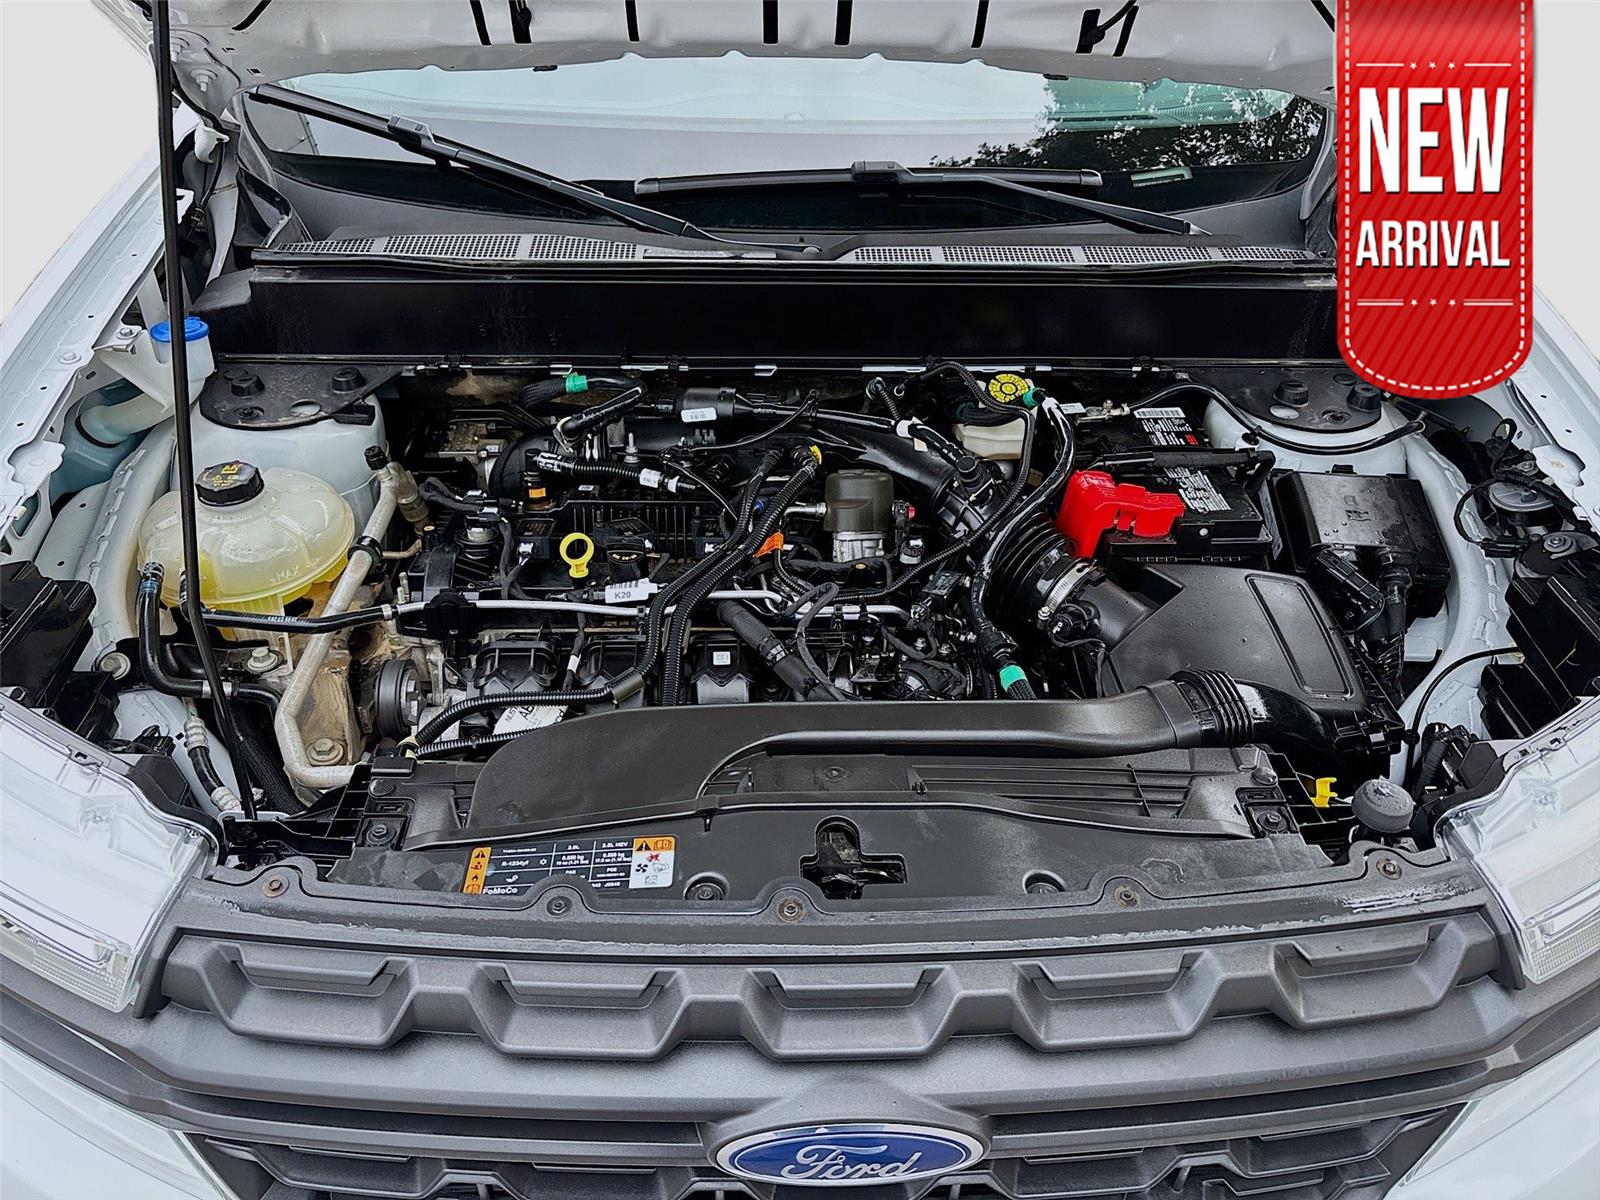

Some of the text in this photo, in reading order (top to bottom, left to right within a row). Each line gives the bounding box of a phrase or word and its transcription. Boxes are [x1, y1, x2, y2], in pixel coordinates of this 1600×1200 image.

[614, 591, 632, 599] K20
[501, 859, 530, 867] R-1234yf
[482, 886, 518, 895] FoMoCo
[780, 1144, 923, 1180] Ford
